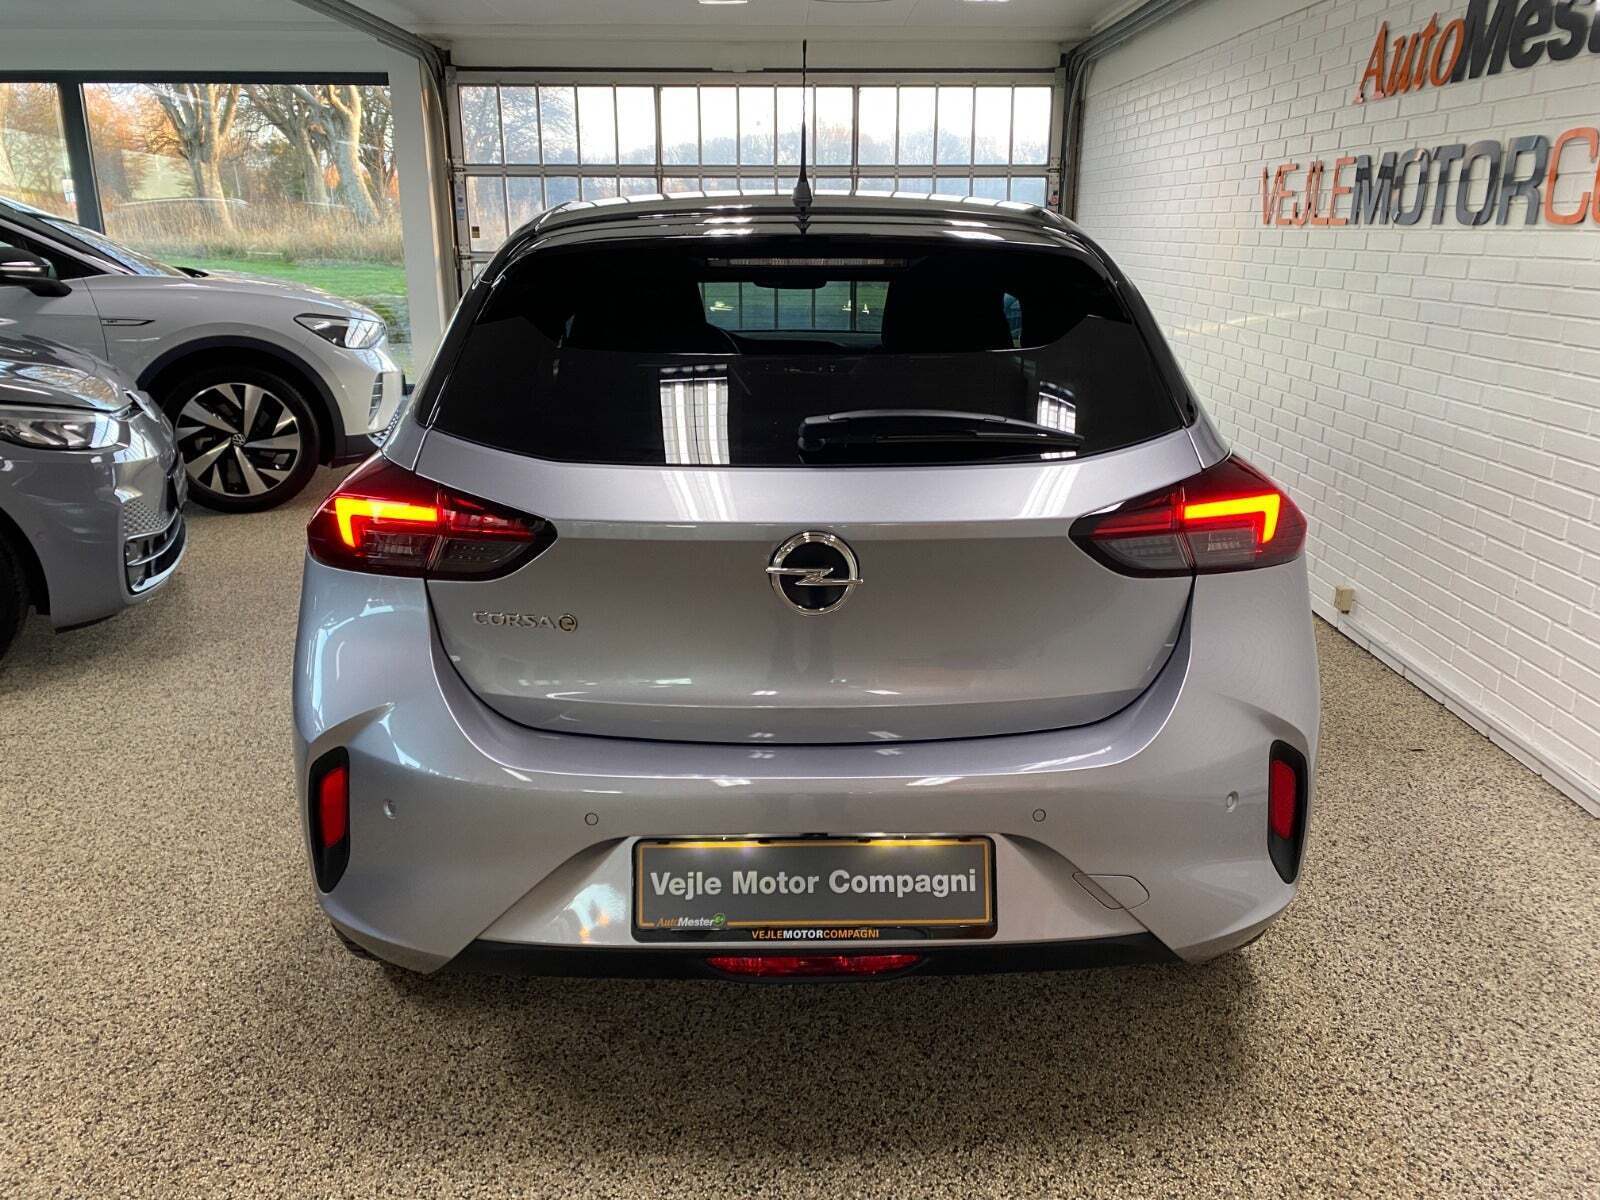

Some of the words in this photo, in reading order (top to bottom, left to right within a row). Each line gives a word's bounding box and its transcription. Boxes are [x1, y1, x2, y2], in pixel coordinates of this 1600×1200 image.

[1262, 127, 1600, 226] VEJLEMOTORC
[473, 612, 557, 629] CORSA
[650, 871, 722, 901] Vejle
[732, 870, 820, 895] Motor
[828, 868, 977, 898] Compagni
[751, 929, 880, 939] VEJLEMOTORCOMPAGNI
